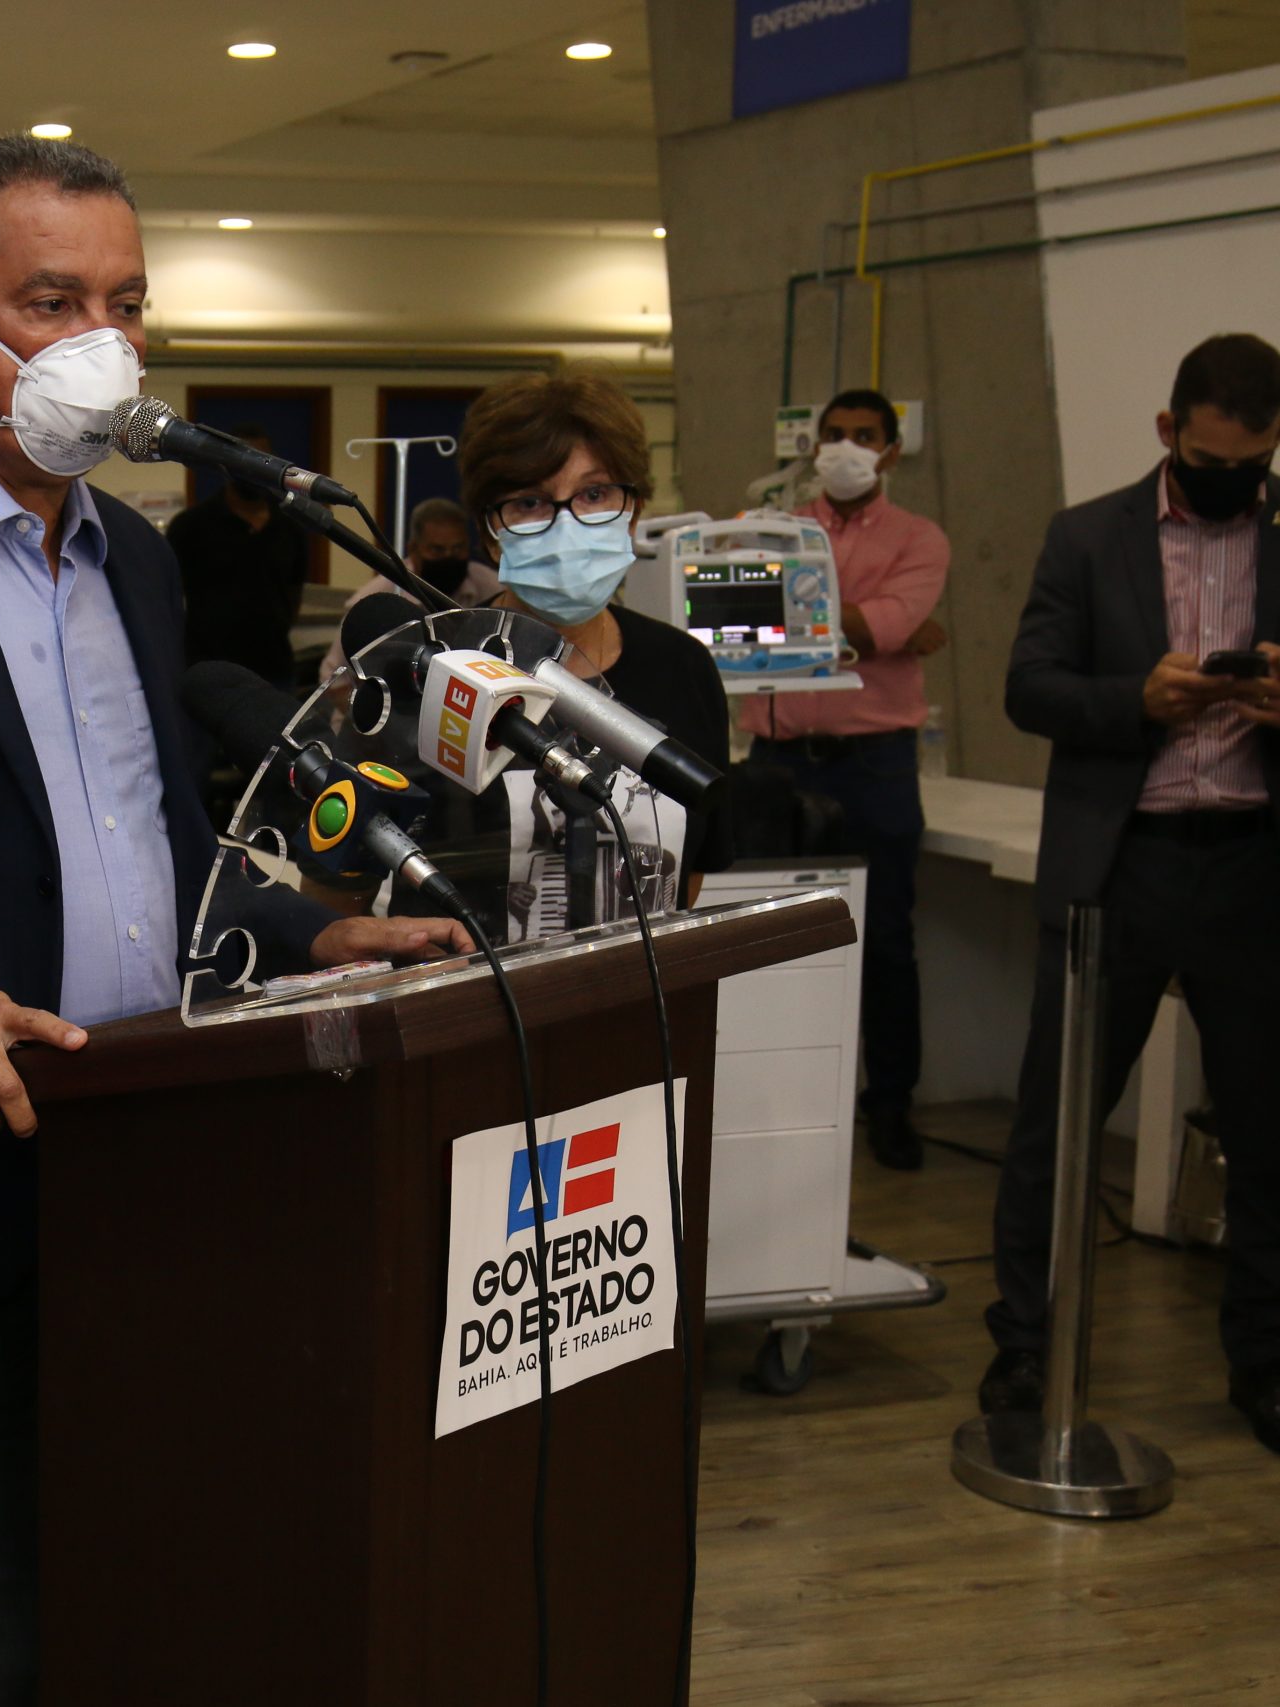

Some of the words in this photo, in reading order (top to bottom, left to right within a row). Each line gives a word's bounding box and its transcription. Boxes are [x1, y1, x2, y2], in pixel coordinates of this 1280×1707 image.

[751, 0, 880, 39] ENFERMAG
[80, 430, 110, 445] 3M
[442, 685, 471, 767] TVE
[472, 1214, 648, 1306] GOVERNO
[458, 1365, 511, 1397] BAHIA.
[516, 1345, 554, 1375] AQI
[559, 1337, 568, 1358] É
[572, 1312, 653, 1351] TRABALHO.
[459, 1308, 514, 1368] DO
[519, 1262, 655, 1346] ESTADO
